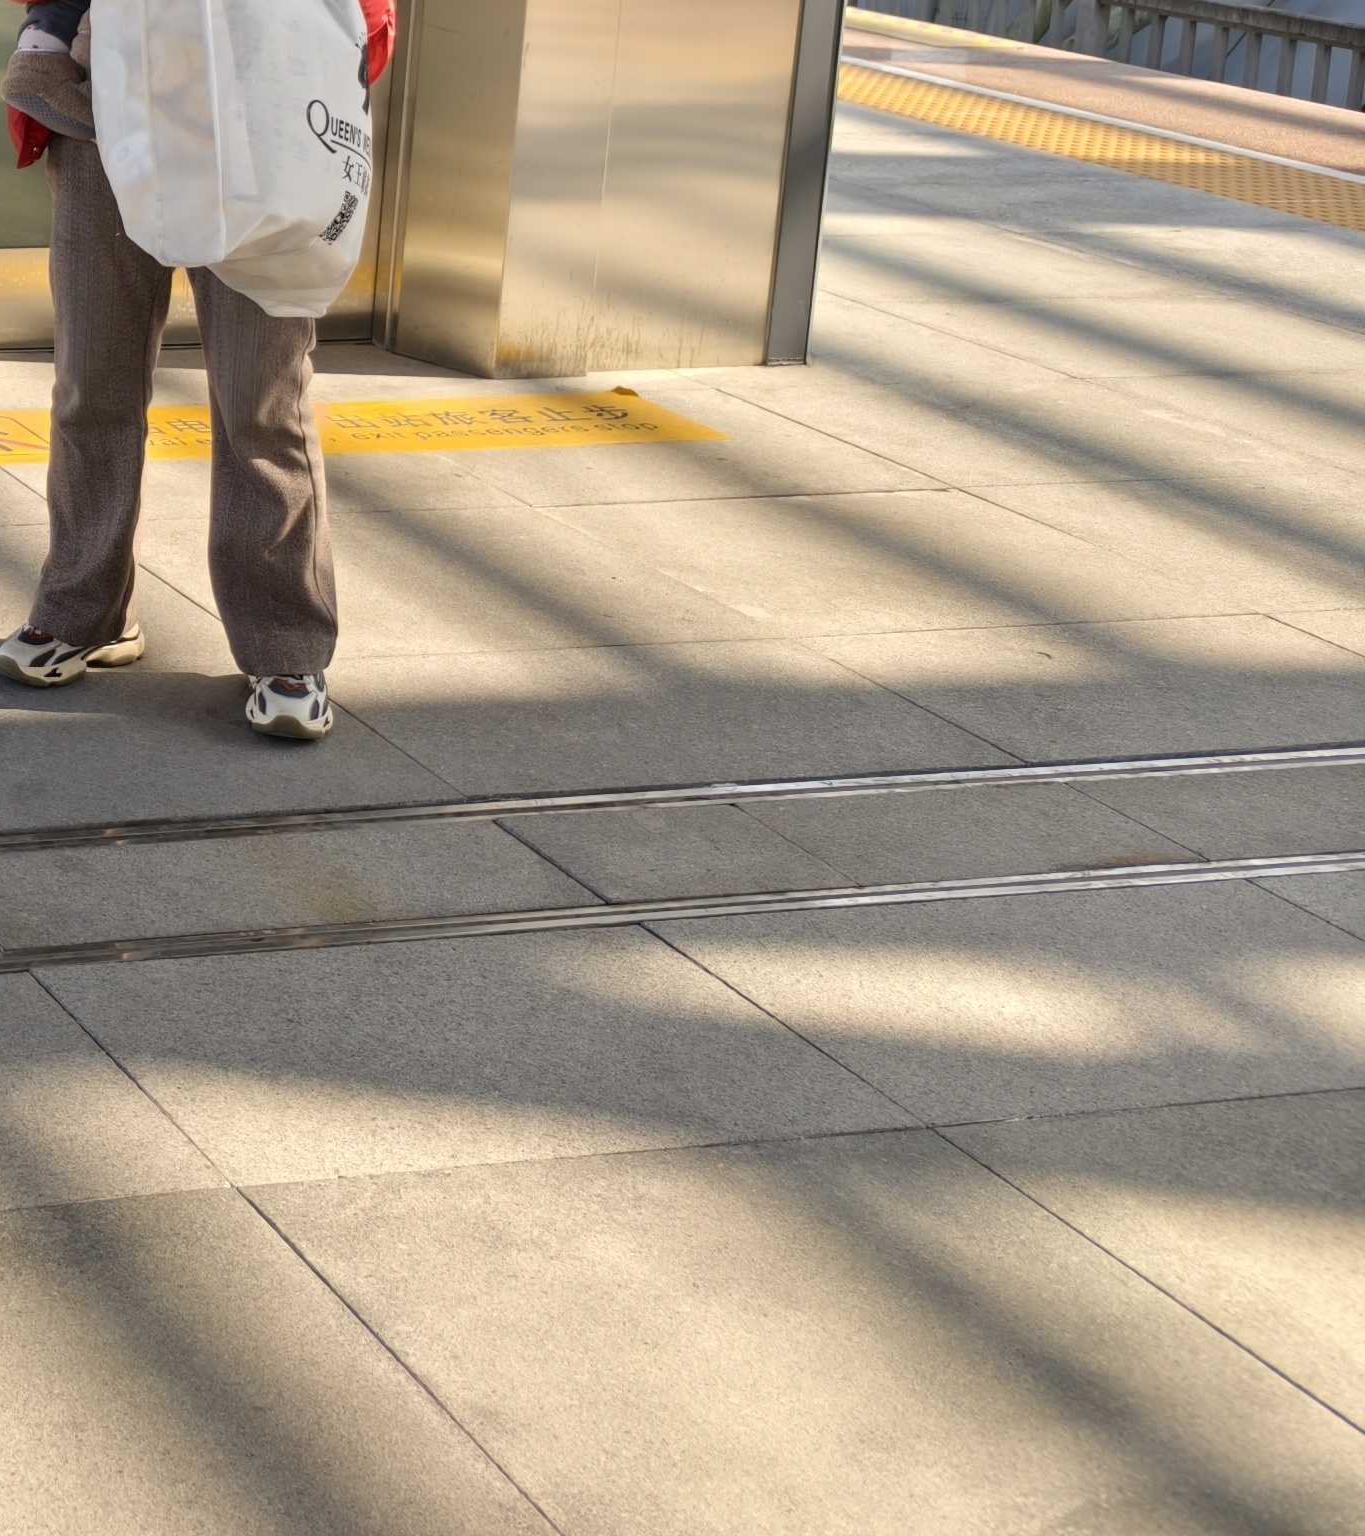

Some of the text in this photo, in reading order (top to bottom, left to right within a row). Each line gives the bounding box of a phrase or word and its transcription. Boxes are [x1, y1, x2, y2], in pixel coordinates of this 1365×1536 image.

[326, 404, 629, 430] 出站旅客止步
[350, 429, 409, 442] exit
[414, 421, 590, 441] passengers
[602, 420, 659, 433] stop
